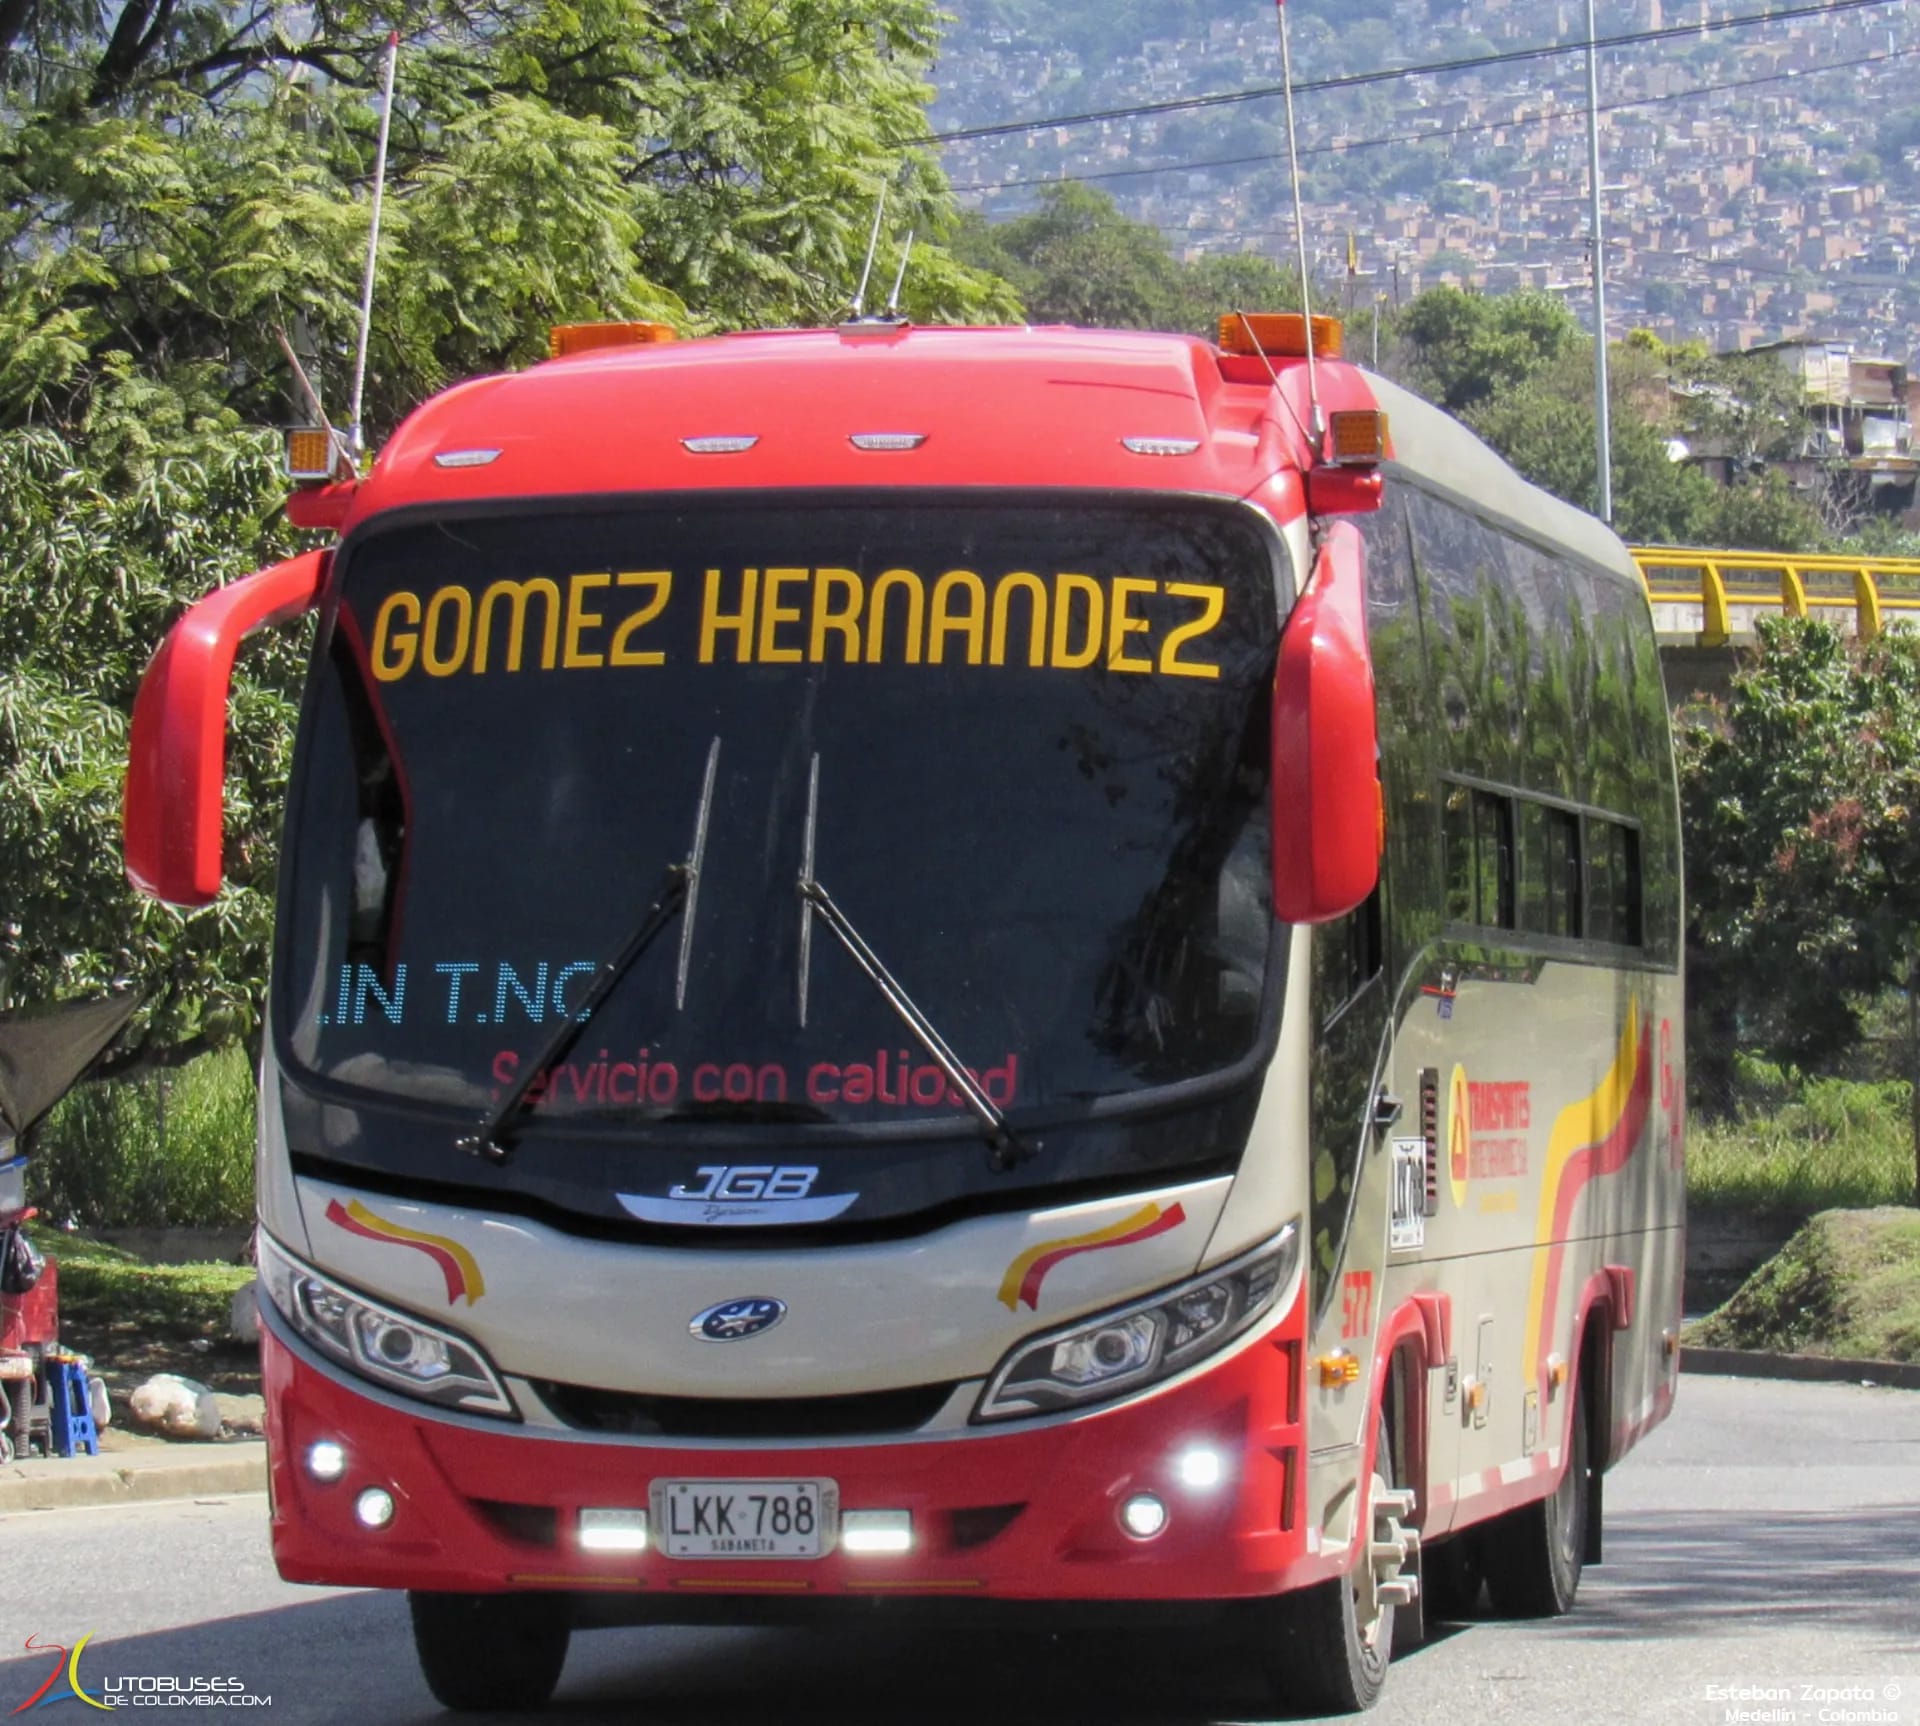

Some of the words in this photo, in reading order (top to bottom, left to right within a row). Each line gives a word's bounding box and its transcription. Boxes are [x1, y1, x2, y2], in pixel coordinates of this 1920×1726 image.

[371, 571, 672, 681] GOMEZ
[699, 568, 1225, 679] HERNANDEZ
[692, 1062, 786, 1103] con
[669, 1165, 819, 1200] JGB
[670, 1496, 736, 1536] LKK
[748, 1496, 815, 1536] 788
